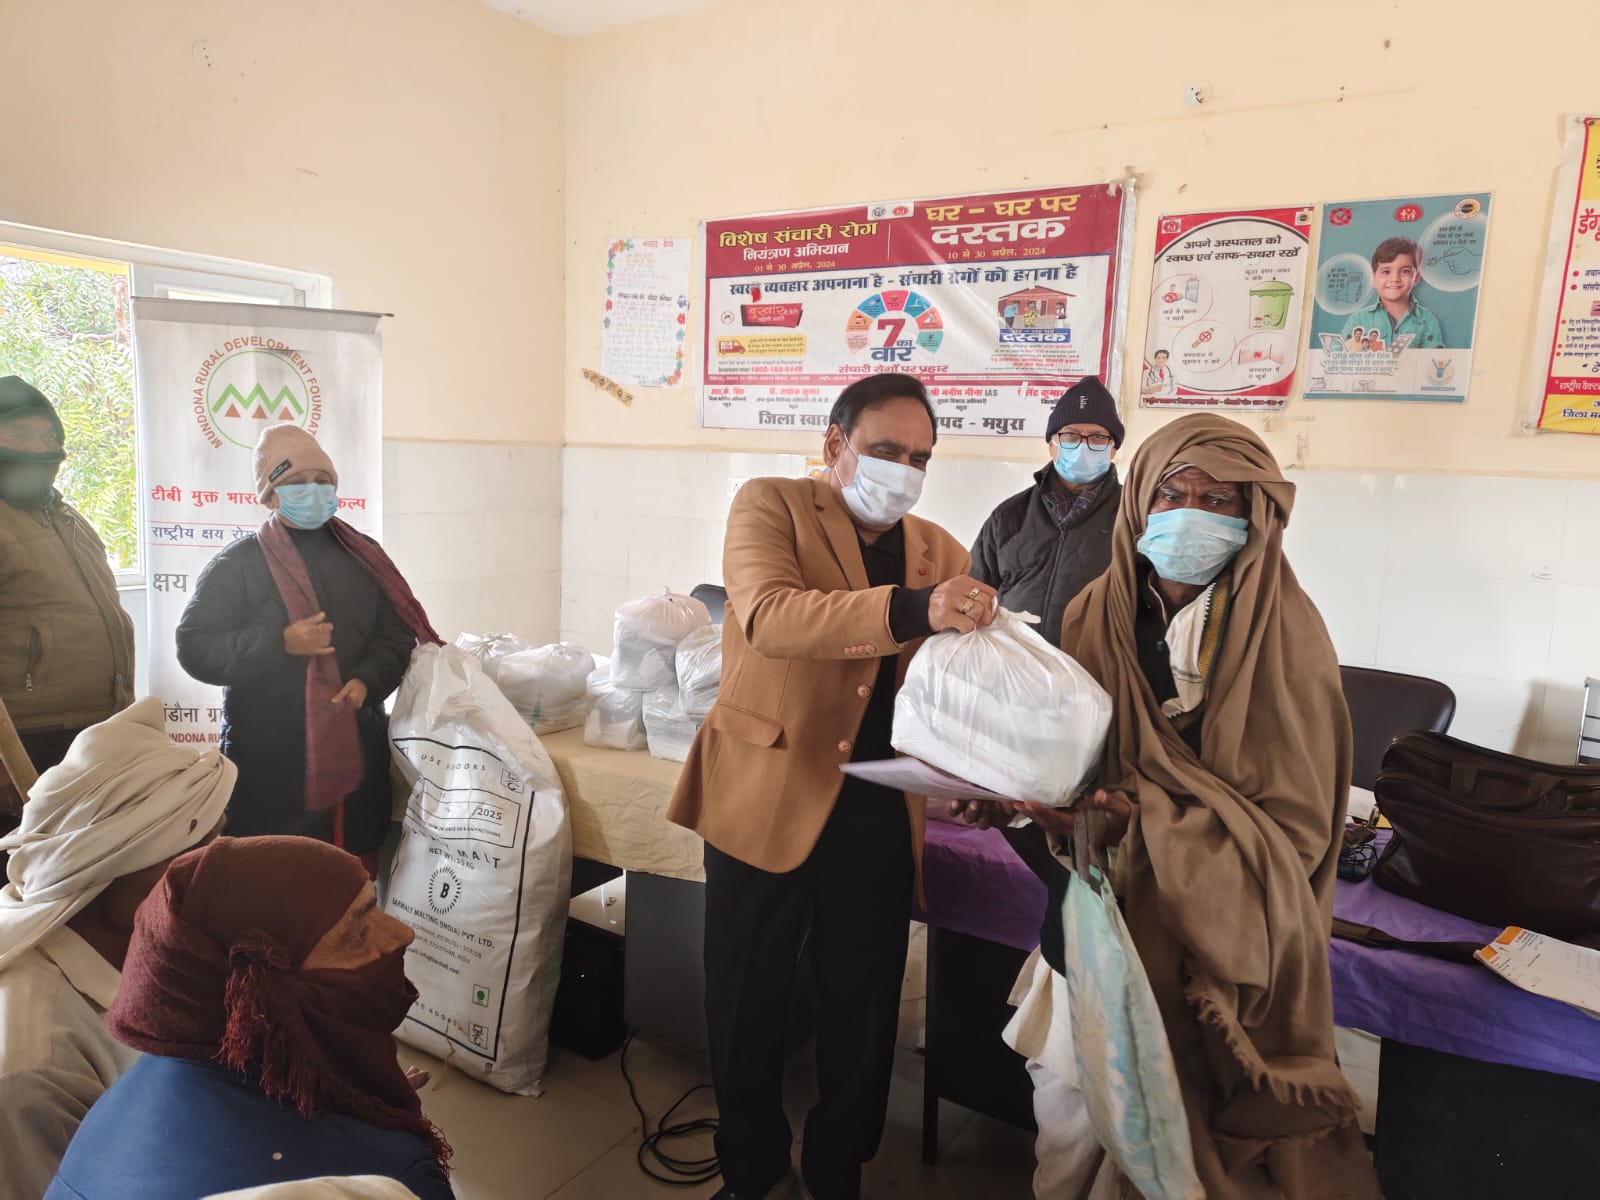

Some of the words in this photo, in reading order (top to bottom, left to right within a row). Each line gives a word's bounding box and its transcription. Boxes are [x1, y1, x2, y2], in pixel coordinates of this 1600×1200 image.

[925, 204, 963, 222] घर
[993, 198, 1036, 217] घर
[1039, 193, 1081, 214] पर
[719, 231, 769, 248] विशेष
[773, 225, 835, 244] संचारी
[839, 221, 880, 239] रोग
[930, 216, 1071, 245] दस्तक
[1184, 238, 1212, 249] अपने
[1214, 236, 1263, 248] अस्पताल
[1265, 234, 1282, 245] को
[743, 246, 791, 261] नियंत्रण
[794, 242, 849, 258] अभियान
[975, 250, 986, 258] 30
[1023, 247, 1046, 256] 2024
[1165, 254, 1194, 264] स्वच्छ
[1196, 251, 1213, 262] एवं
[1278, 247, 1302, 258] रखें
[816, 261, 836, 269] 2024
[764, 280, 809, 294] व्यवहार
[812, 275, 870, 292] अपनाना
[870, 272, 884, 288] है
[899, 270, 943, 287] संचारी
[984, 266, 1008, 283] को
[1062, 263, 1080, 279] है
[877, 318, 906, 348] 7
[896, 339, 913, 348] का
[1001, 332, 1070, 343] दस्तक
[223, 336, 313, 376] DEVELOPMENT
[870, 346, 916, 362] वार
[195, 349, 225, 386] RURAL
[838, 364, 870, 374] संचारी
[874, 363, 900, 373] रोगों
[901, 365, 918, 374] पर
[919, 364, 949, 374] प्रहार
[985, 389, 998, 397] IAS
[306, 377, 322, 437] FOUNDAT
[193, 388, 224, 449] MUNDONA
[759, 410, 795, 425] जिला
[982, 417, 1026, 434] मथुरा
[150, 485, 182, 503] टीबी
[191, 489, 219, 507] मुक्त
[152, 524, 194, 540] राष्ट्रीय
[202, 528, 224, 540] क्षय
[152, 573, 188, 593] क्षय
[168, 732, 206, 743] NDONA
[429, 847, 442, 855] NET
[457, 849, 501, 869] MALT
[440, 882, 450, 899] B
[478, 937, 495, 949] LTD.
